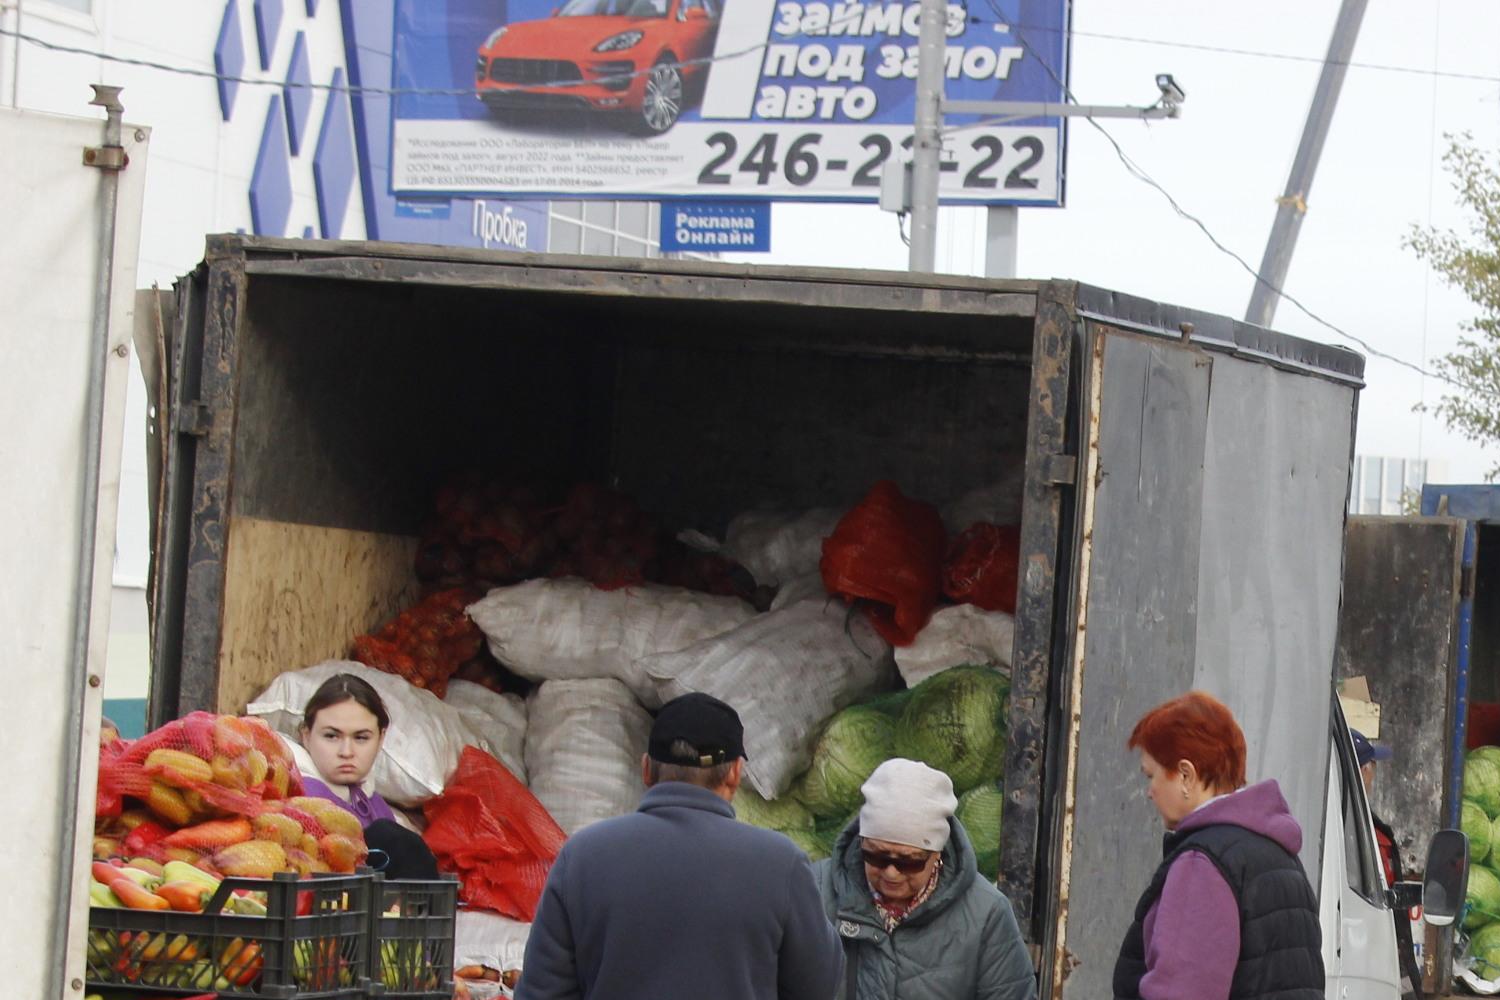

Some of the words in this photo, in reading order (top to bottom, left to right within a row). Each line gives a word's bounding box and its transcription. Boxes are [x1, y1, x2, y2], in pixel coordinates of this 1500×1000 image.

[763, 44, 864, 82] под
[755, 85, 877, 120] авто
[472, 200, 527, 249] Пробка
[675, 213, 754, 229] Реклама
[675, 229, 754, 245] Онлайн
